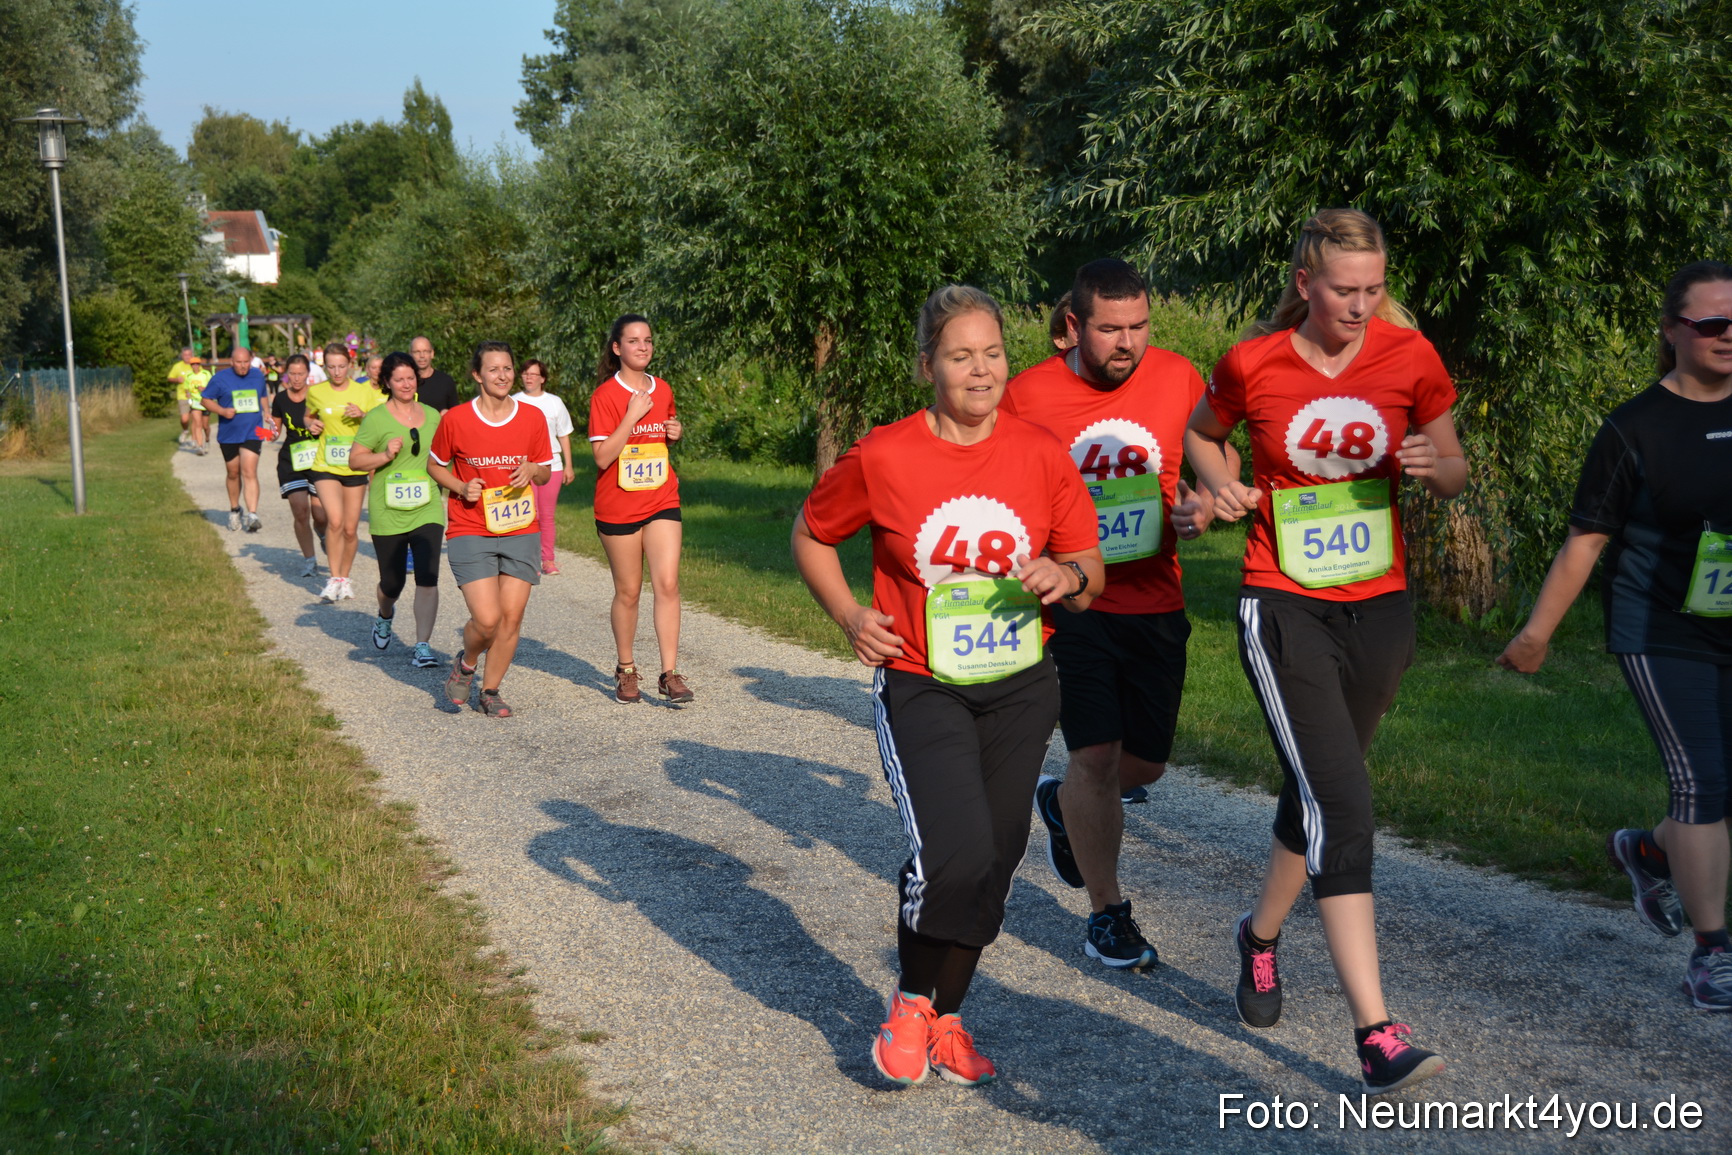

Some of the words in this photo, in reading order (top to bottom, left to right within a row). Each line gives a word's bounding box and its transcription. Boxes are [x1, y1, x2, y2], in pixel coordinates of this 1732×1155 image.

[625, 462, 662, 478] 1411
[395, 486, 422, 499] 518
[492, 500, 531, 521] 1412
[1292, 501, 1333, 513] firmenlauf
[1098, 509, 1146, 541] 547
[1303, 521, 1370, 559] 540
[1308, 565, 1332, 573] Annika
[1333, 560, 1370, 572] Engelmann
[944, 597, 985, 609] firmenlauf
[953, 620, 1021, 656] 544
[957, 663, 987, 671] Susanne
[988, 660, 1017, 668] Denskus
